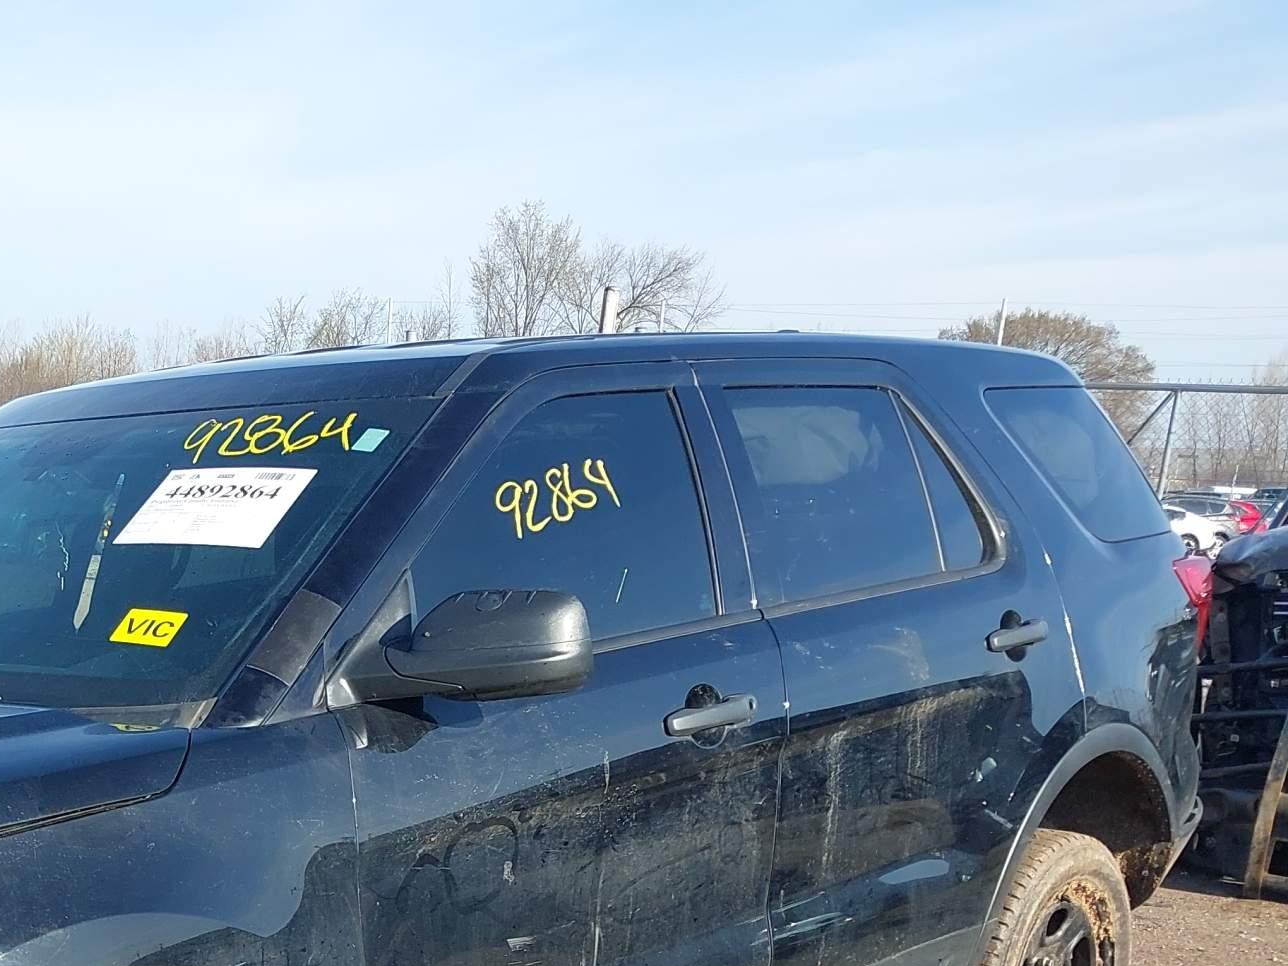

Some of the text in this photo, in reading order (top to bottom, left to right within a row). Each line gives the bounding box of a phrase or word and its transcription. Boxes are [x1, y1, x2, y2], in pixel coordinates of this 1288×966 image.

[184, 412, 357, 463] 92864
[166, 484, 282, 499] 44892864
[496, 459, 621, 540] 92864
[125, 617, 175, 638] VIC
